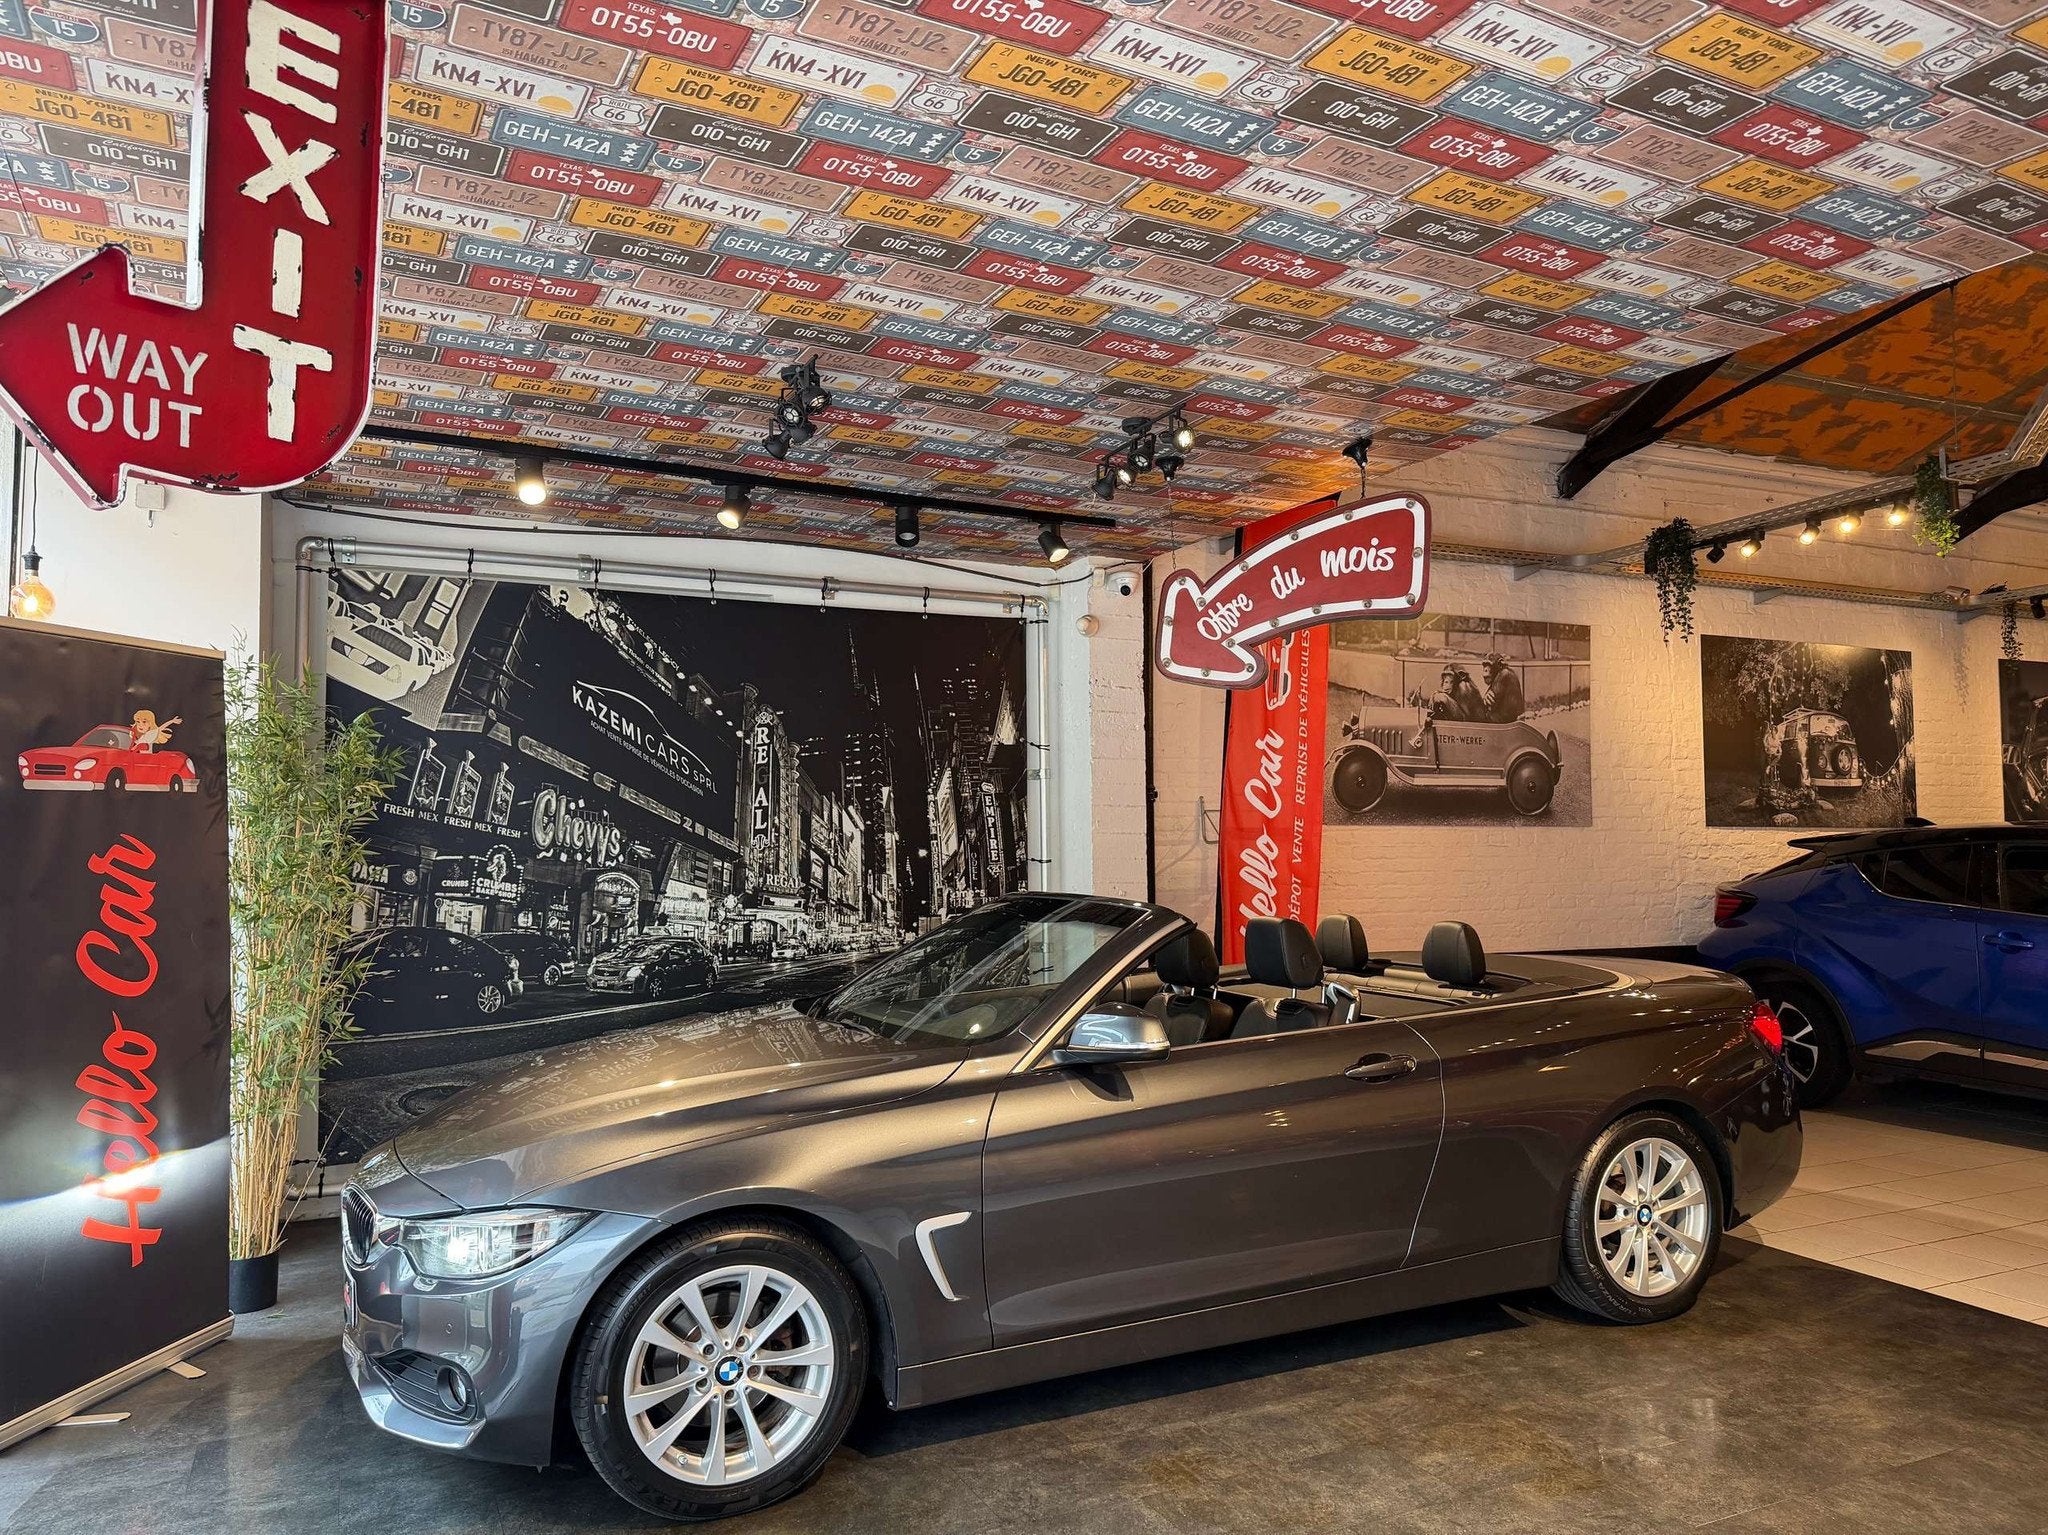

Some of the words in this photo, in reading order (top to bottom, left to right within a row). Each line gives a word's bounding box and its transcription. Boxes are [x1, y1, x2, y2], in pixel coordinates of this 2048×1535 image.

[402, 7, 422, 24] 15
[627, 1, 657, 16] TEXAS
[52, 19, 77, 38] 15
[1375, 39, 1406, 54] NEW
[1411, 49, 1443, 66] YORK
[1025, 53, 1059, 69] NEW
[1063, 63, 1100, 80] YORK
[1267, 73, 1291, 87] ROUTE
[1588, 71, 1610, 83] 66
[686, 67, 722, 82] NEW
[728, 77, 767, 94] YORK
[933, 85, 957, 98] ROUTE
[1252, 84, 1272, 99] 66
[1796, 72, 1887, 112] GEH-142A
[35, 88, 74, 101] NEW
[83, 98, 129, 114] YORK
[923, 95, 947, 110] 66
[1461, 84, 1553, 126] GEH-142A
[604, 109, 626, 121] 66
[712, 120, 763, 136] California
[1028, 107, 1077, 125] California
[1133, 97, 1232, 138] GEH-142A
[402, 127, 458, 144] California
[503, 119, 612, 157] GEH-142A
[814, 110, 918, 148] GEH-142A
[102, 139, 160, 155] California
[964, 147, 984, 161] 15
[1158, 143, 1182, 155] TEXAS
[1270, 137, 1287, 151] 15
[558, 161, 584, 172] TEXAS
[667, 156, 684, 170] 15
[854, 153, 878, 164] TEXAS
[232, 0, 341, 442] EXIT
[1533, 211, 1608, 239] GEH-142A
[1815, 198, 1891, 228] GEH-142A
[987, 224, 1073, 257] GEH-142A
[1257, 220, 1338, 248] GEH-142A
[464, 244, 555, 270] GEH-142A
[723, 236, 812, 264] GEH-142A
[66, 322, 208, 396] WAY
[67, 384, 203, 448] OUT
[1270, 564, 1306, 599] du
[1320, 537, 1397, 577] mois
[1298, 629, 1311, 716] VÉHICULES
[572, 685, 641, 745] KAZEMI
[645, 734, 689, 775] CARS
[693, 769, 717, 794] SPRL
[607, 731, 622, 745] VENTE
[1297, 716, 1308, 738] DE
[755, 726, 771, 830] REGAL
[1244, 728, 1284, 819] Car
[1295, 740, 1308, 805] REPRISE
[384, 804, 414, 818] FRESH
[418, 810, 438, 823] MEX
[444, 816, 471, 830] FRESH
[474, 822, 492, 833] MEX
[497, 827, 521, 839] FRESH
[532, 788, 621, 866] Chevys
[985, 795, 999, 863] EMPIRE
[1291, 817, 1304, 864] VENTE
[441, 879, 469, 888] CRUMBS
[476, 877, 518, 893] CRUMBS
[1239, 823, 1279, 937] ello
[75, 832, 160, 998] Car
[75, 1011, 163, 1267] Hello
